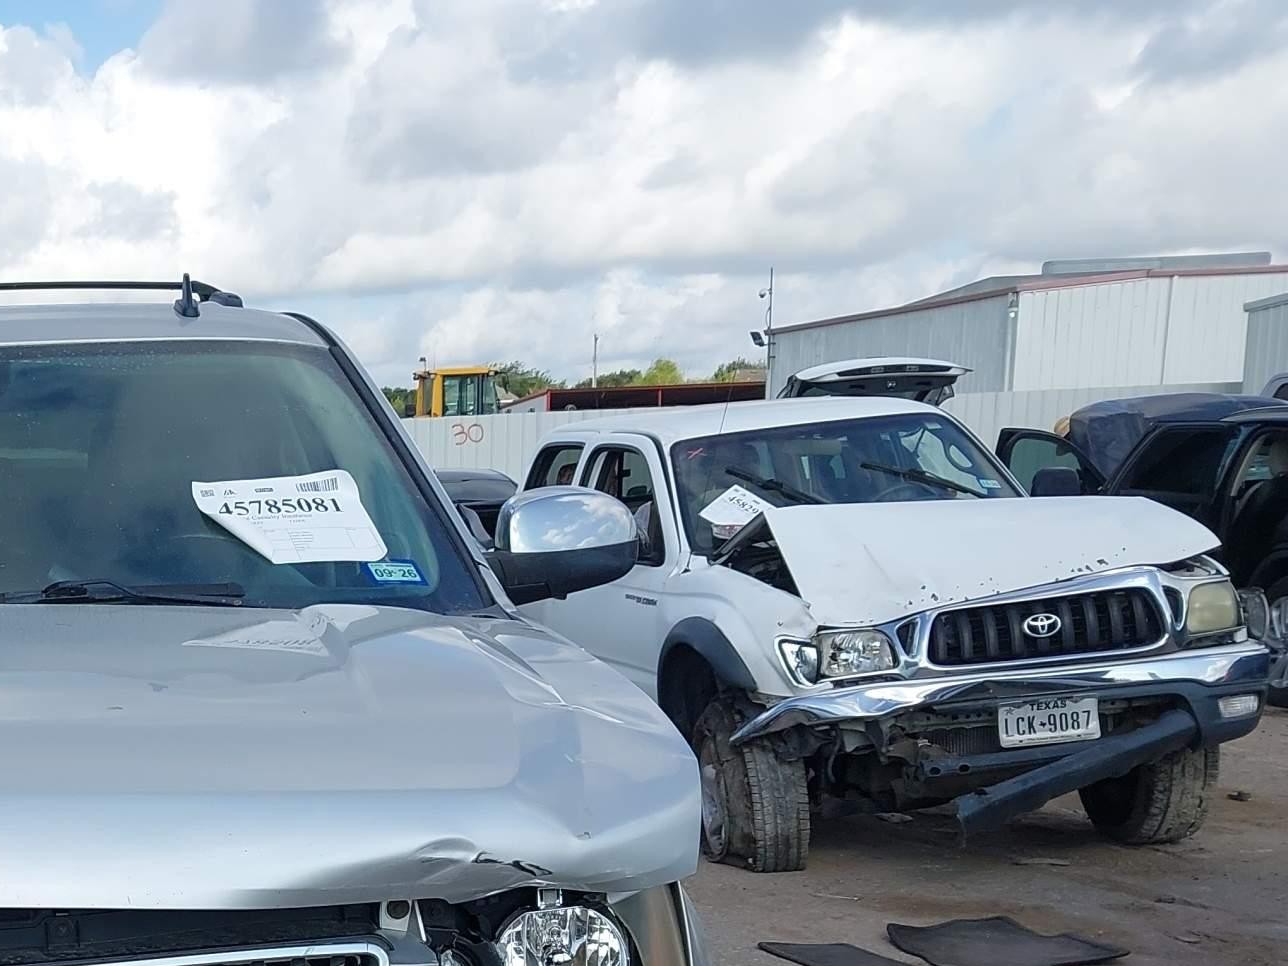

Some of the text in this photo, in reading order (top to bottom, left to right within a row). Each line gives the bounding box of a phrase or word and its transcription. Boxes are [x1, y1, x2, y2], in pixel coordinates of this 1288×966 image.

[451, 410, 484, 446] 30
[218, 497, 344, 516] 45785081
[1030, 700, 1067, 711] TEXAS
